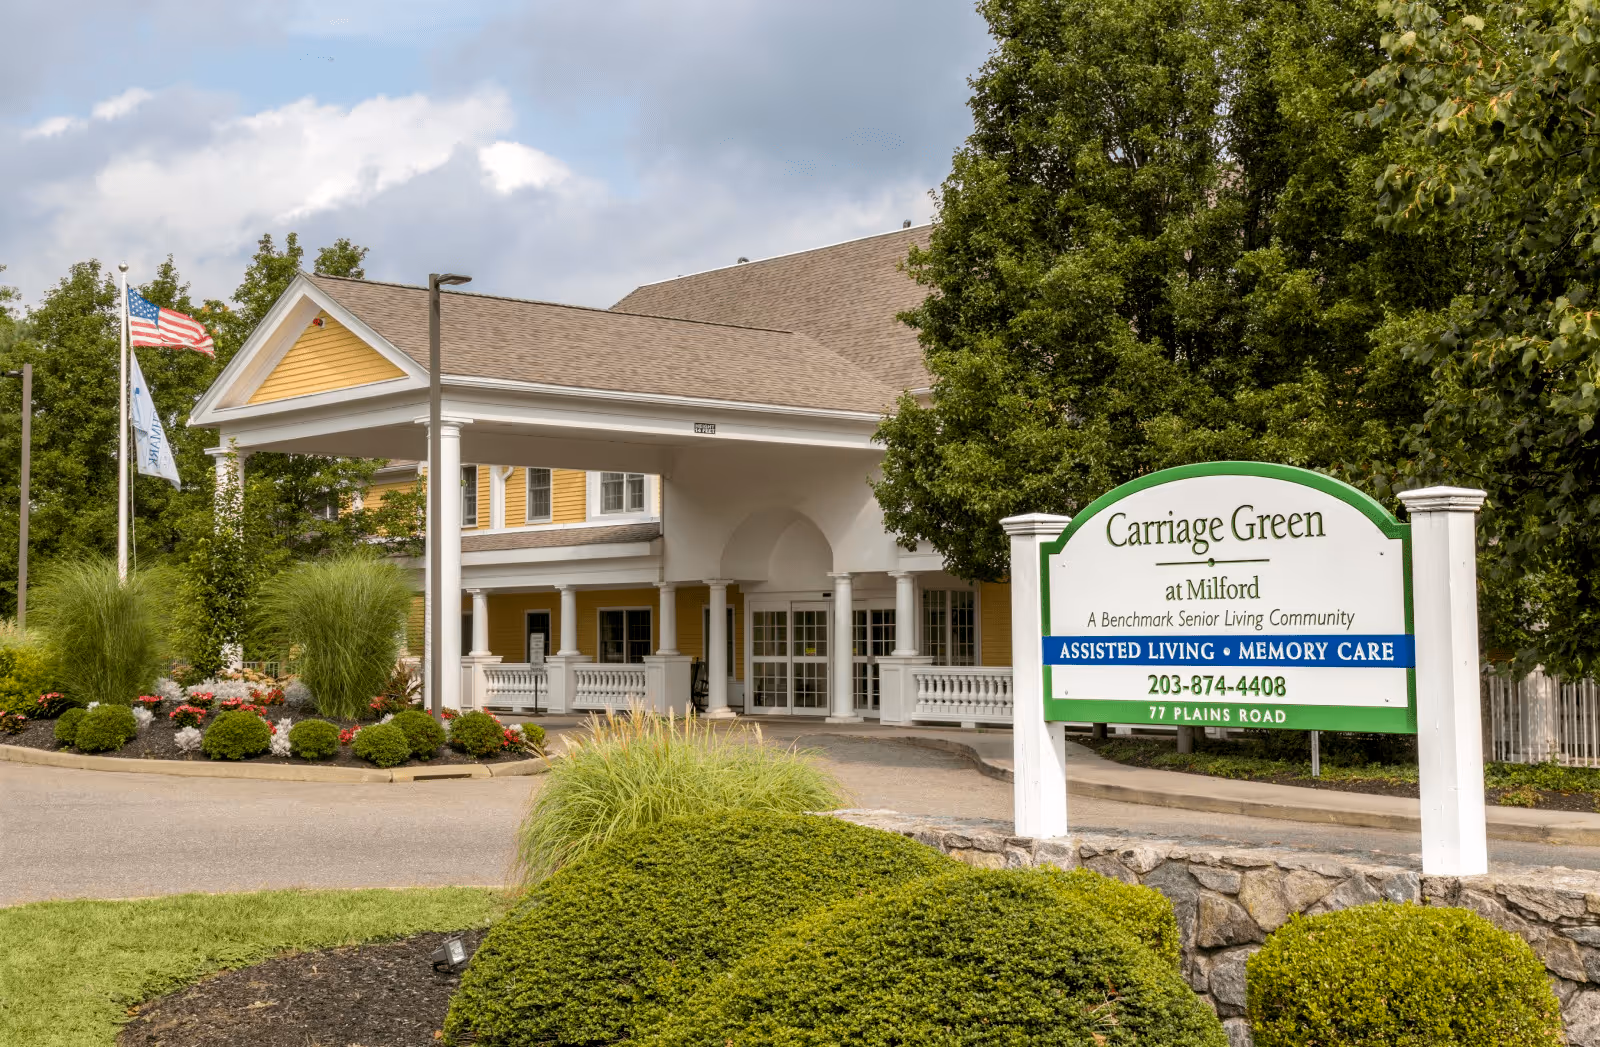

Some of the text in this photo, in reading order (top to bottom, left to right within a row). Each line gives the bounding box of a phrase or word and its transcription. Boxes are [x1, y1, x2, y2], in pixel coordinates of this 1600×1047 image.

[1106, 504, 1326, 555] Carriage Green
[1165, 575, 1261, 601] at Milford
[1087, 608, 1356, 631] A Benchmark Senior Living Community
[1060, 641, 1395, 661] ASSISTED LIVING MEMORY CARE
[1147, 674, 1287, 697] 203-874-4408
[1149, 706, 1287, 724] 77 PLAINS ROAD
